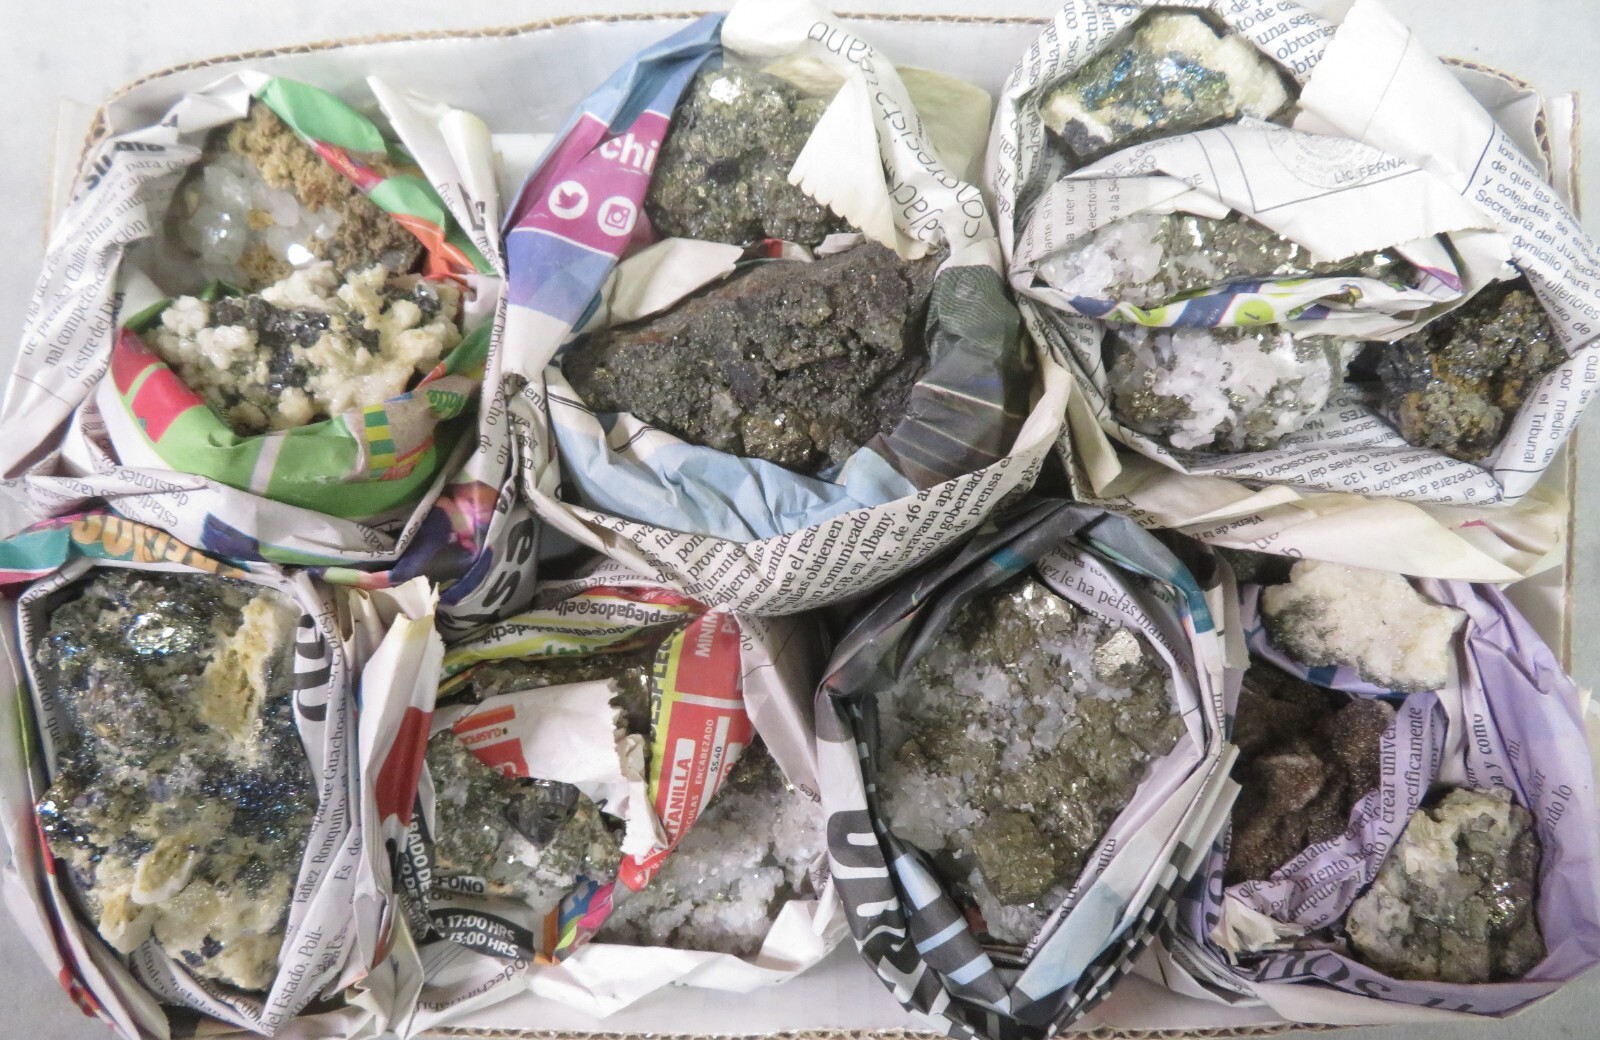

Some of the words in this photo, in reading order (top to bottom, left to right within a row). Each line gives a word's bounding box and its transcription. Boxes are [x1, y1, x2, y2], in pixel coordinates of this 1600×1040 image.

[1256, 22, 1290, 45] una
[600, 134, 656, 172] chi
[1491, 159, 1508, 175] de
[1509, 170, 1532, 192] que
[1533, 186, 1550, 204] las
[1066, 199, 1075, 226] tener
[1496, 183, 1552, 222] cotejadas
[1535, 227, 1556, 246] del
[1564, 269, 1590, 293] para
[1572, 321, 1591, 336] de
[1560, 369, 1573, 391] por
[1550, 399, 1568, 440] medio
[1523, 412, 1547, 463] Tribunal
[1265, 452, 1329, 475] disposición
[1308, 466, 1327, 479] del
[1374, 460, 1445, 491] publicación
[968, 471, 1003, 518] prensa
[894, 525, 909, 542] de
[906, 504, 921, 524] 46
[899, 509, 940, 562] caravana
[1216, 527, 1229, 537] de
[806, 519, 844, 581] obtienen
[820, 510, 871, 588] comunicado
[850, 562, 866, 581] en
[863, 511, 897, 561] Albany.
[778, 572, 797, 597] que
[790, 554, 801, 571] el
[1061, 571, 1074, 586] le
[1076, 578, 1094, 596] ha
[695, 719, 714, 785] ENCABEZADO
[1382, 783, 1397, 825] crear
[1559, 785, 1573, 802] lo
[447, 915, 488, 930] 17:00
[448, 932, 487, 945] 13:00
[298, 925, 323, 960] Poli-
